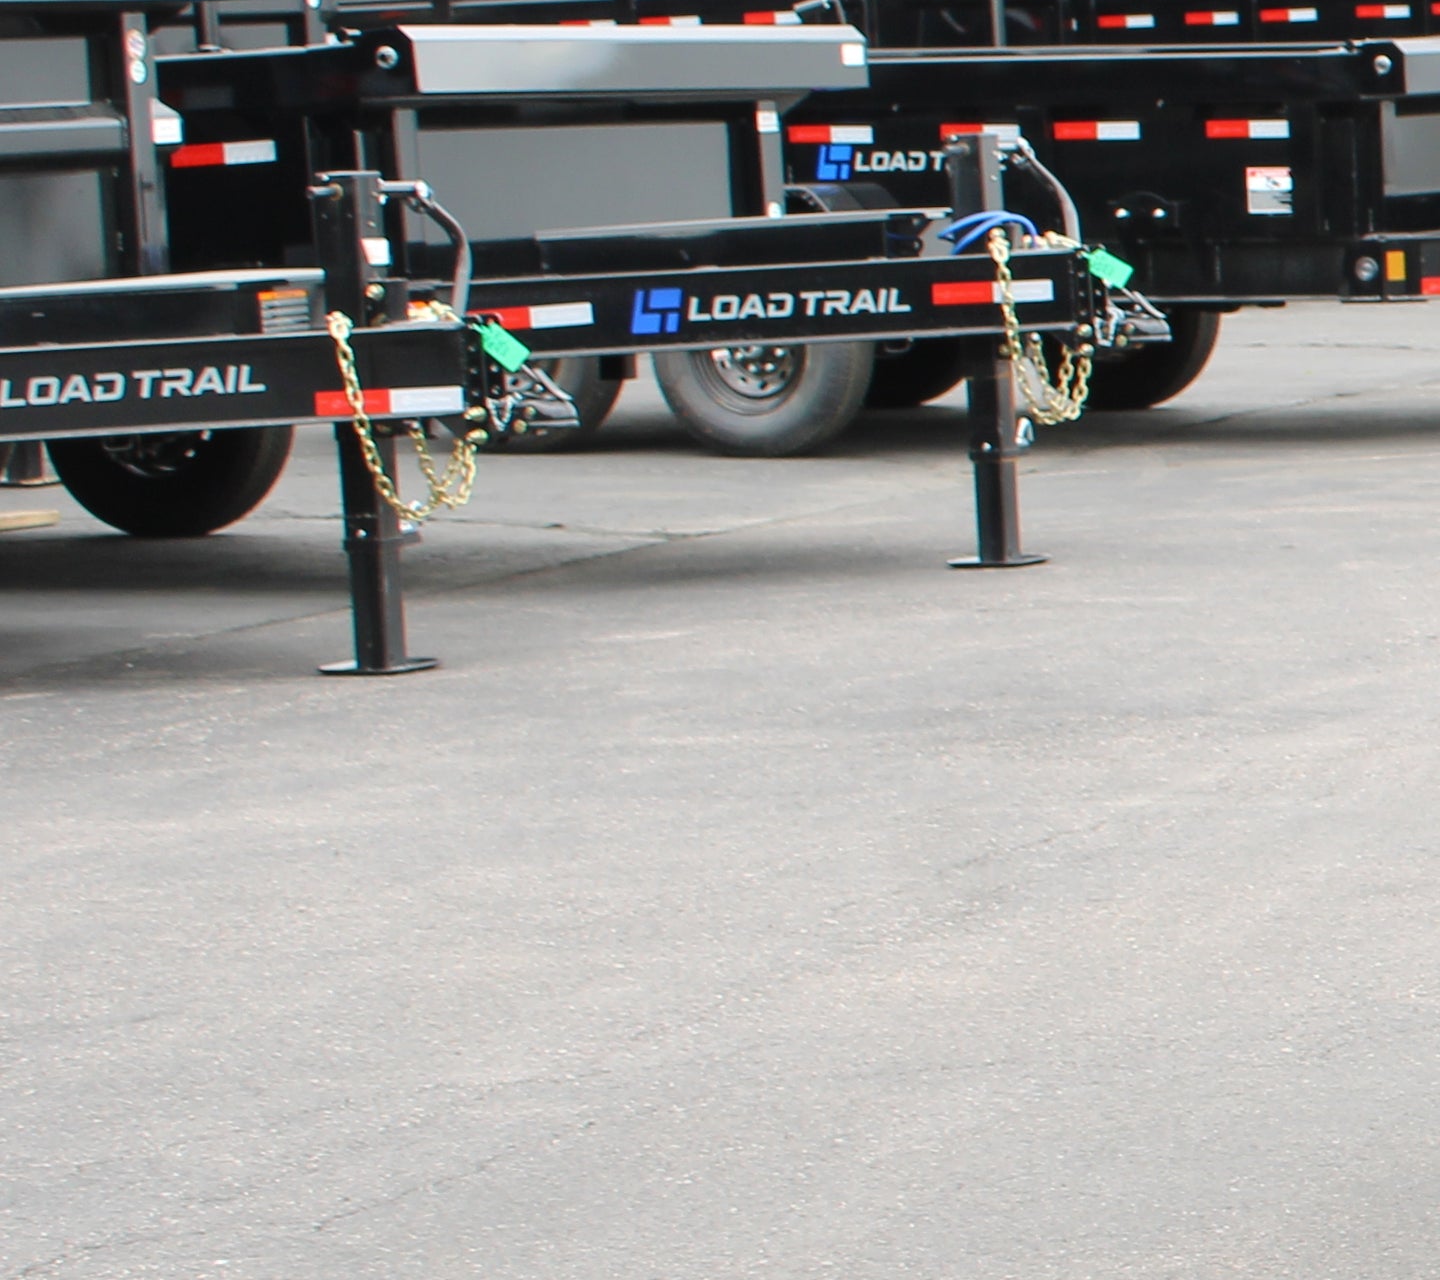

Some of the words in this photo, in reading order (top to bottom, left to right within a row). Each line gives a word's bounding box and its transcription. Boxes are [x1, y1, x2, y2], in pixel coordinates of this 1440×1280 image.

[855, 150, 928, 173] LOAD
[687, 292, 796, 322] LOAD
[800, 287, 912, 317] TRAIL
[0, 372, 127, 408] LOAD
[132, 364, 267, 399] TRAIL
